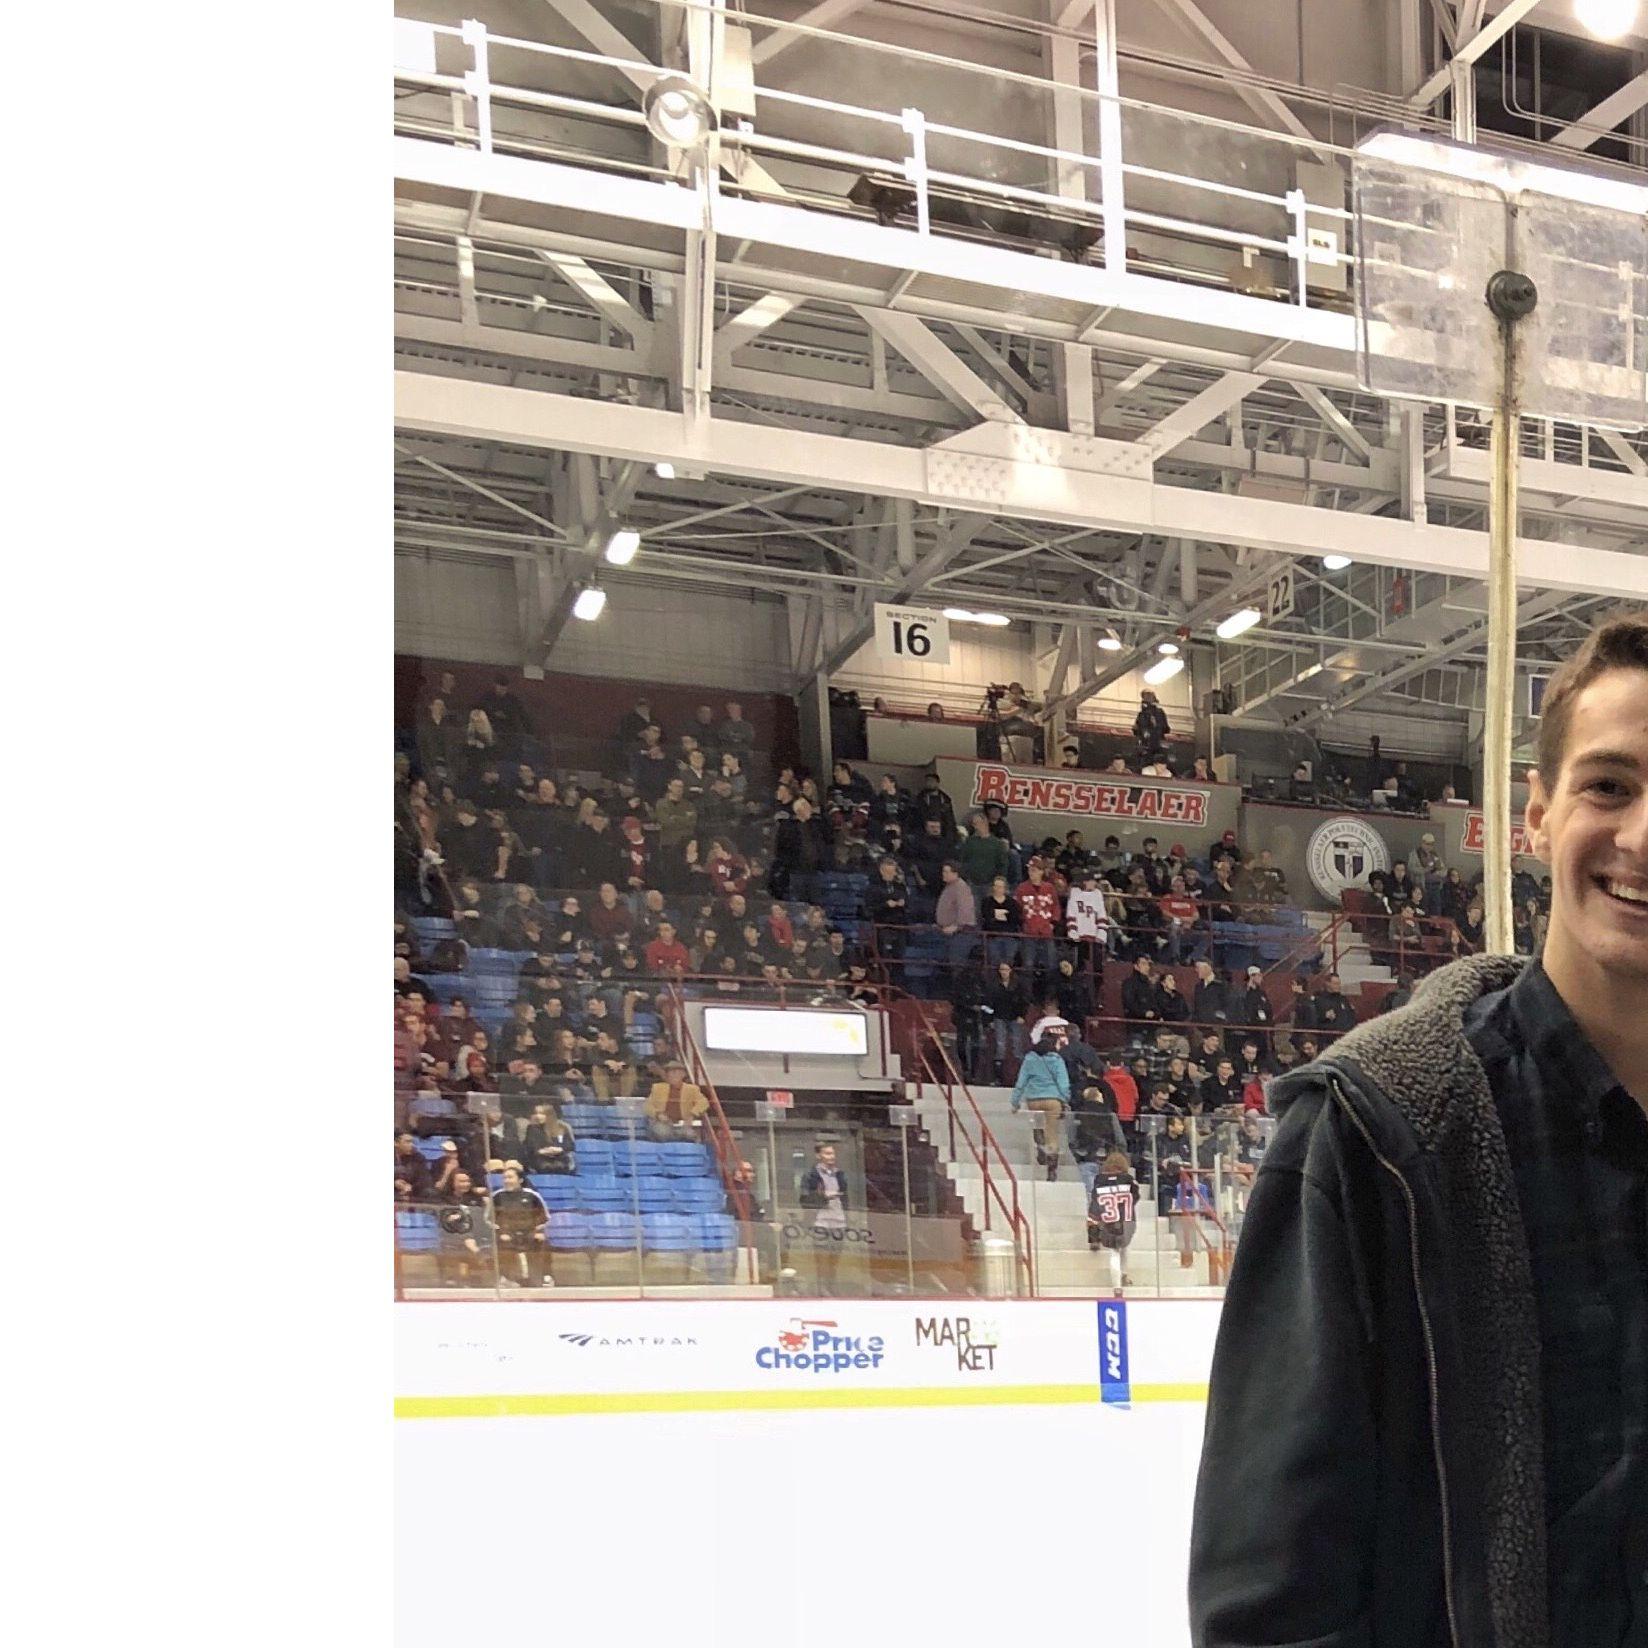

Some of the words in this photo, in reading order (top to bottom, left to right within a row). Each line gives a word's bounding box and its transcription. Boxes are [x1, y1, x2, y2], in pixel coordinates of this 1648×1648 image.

[1272, 575, 1290, 616] 22
[893, 620, 931, 657] 16
[974, 766, 1208, 824] RENSSELAER
[1097, 1190, 1134, 1223] 37
[811, 1329, 884, 1352] Price
[915, 1317, 971, 1347] MAR
[756, 1347, 885, 1374] Chopper
[957, 1344, 997, 1371] KET
